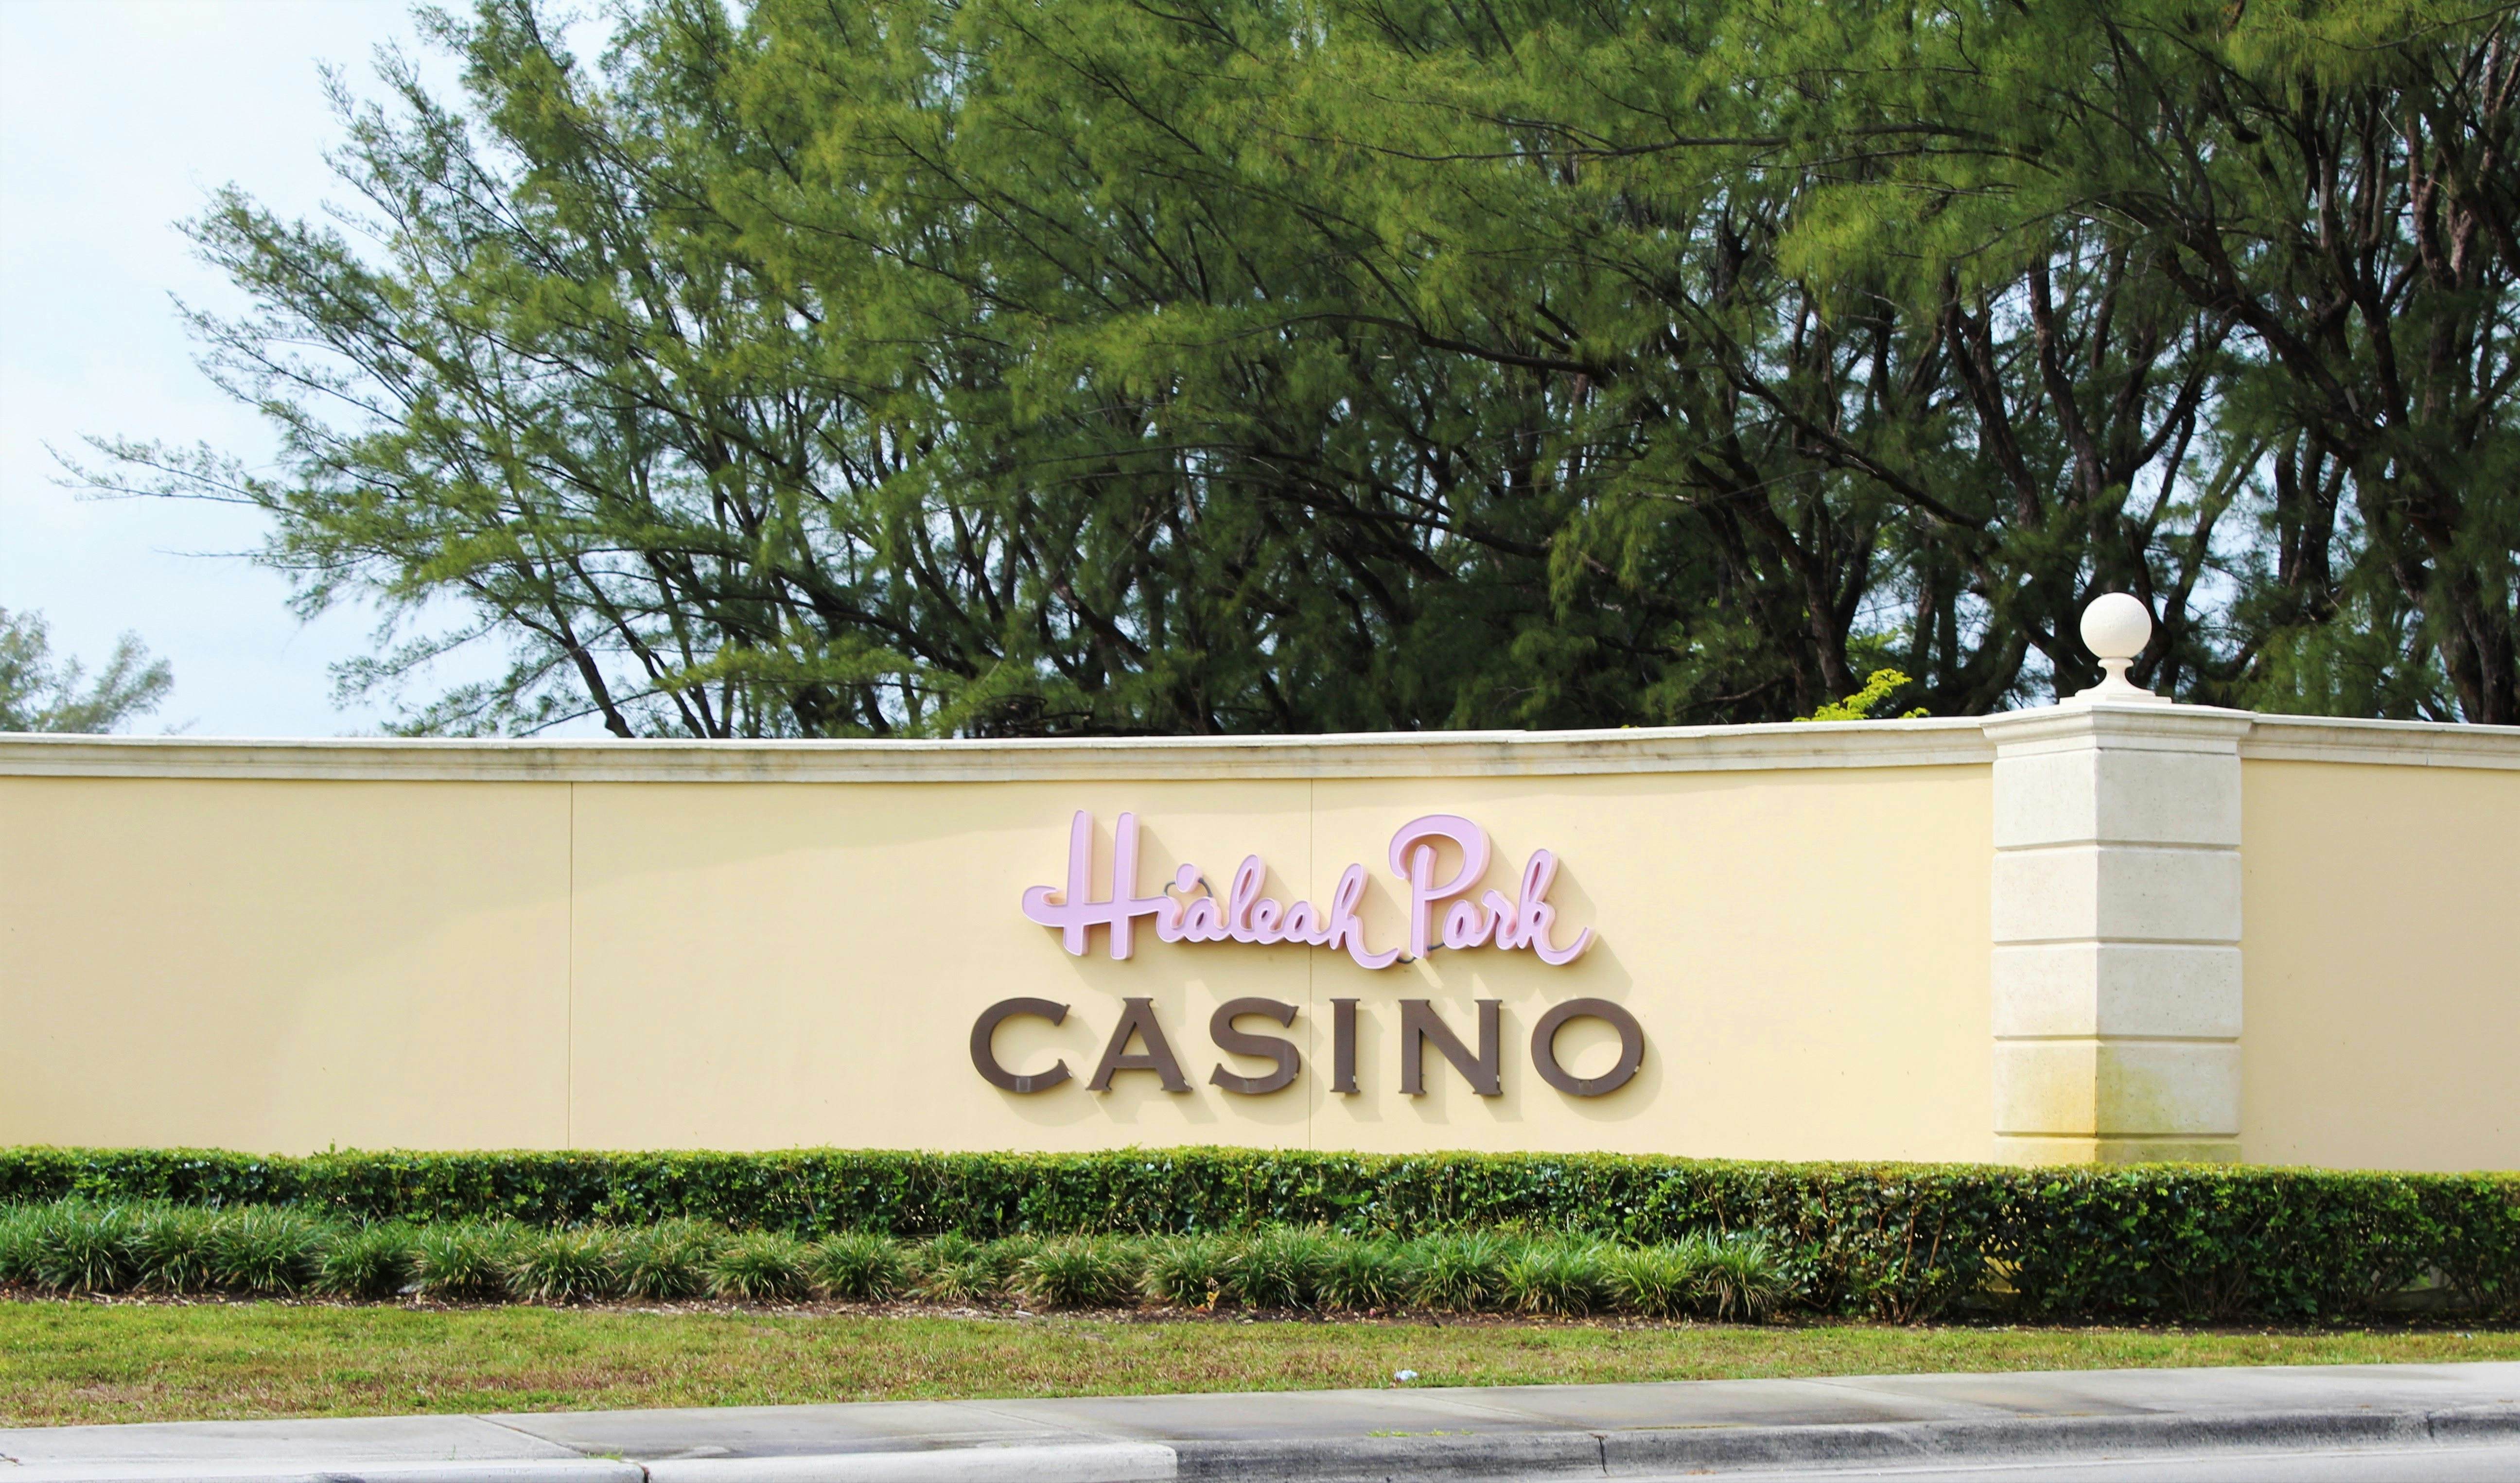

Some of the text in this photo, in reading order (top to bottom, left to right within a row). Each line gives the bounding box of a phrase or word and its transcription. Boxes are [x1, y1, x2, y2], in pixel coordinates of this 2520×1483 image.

[1022, 810, 1597, 970] Hialeah Park
[969, 996, 1645, 1096] CASINO
